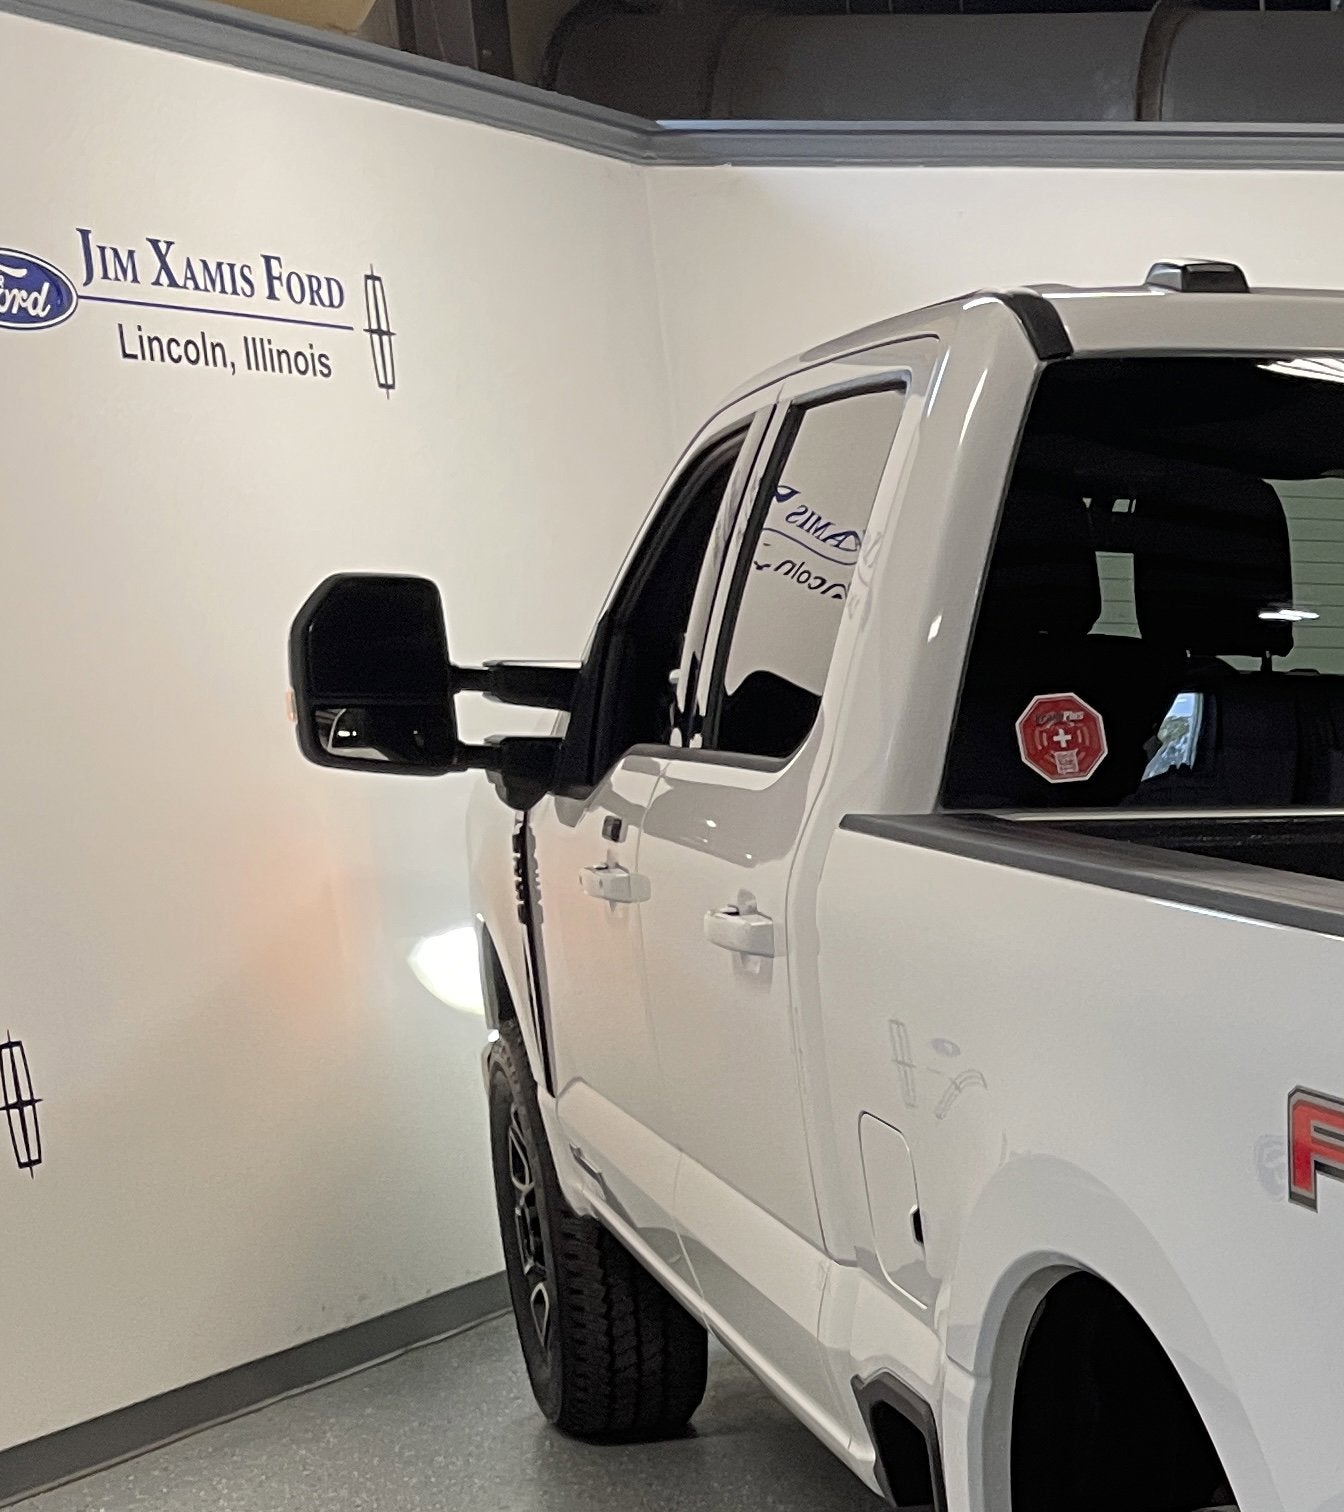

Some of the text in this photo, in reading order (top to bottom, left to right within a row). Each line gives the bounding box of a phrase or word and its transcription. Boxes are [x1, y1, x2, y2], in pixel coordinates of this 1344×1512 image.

[0, 263, 52, 318] ord
[117, 323, 333, 379] Lincoln, Illinois
